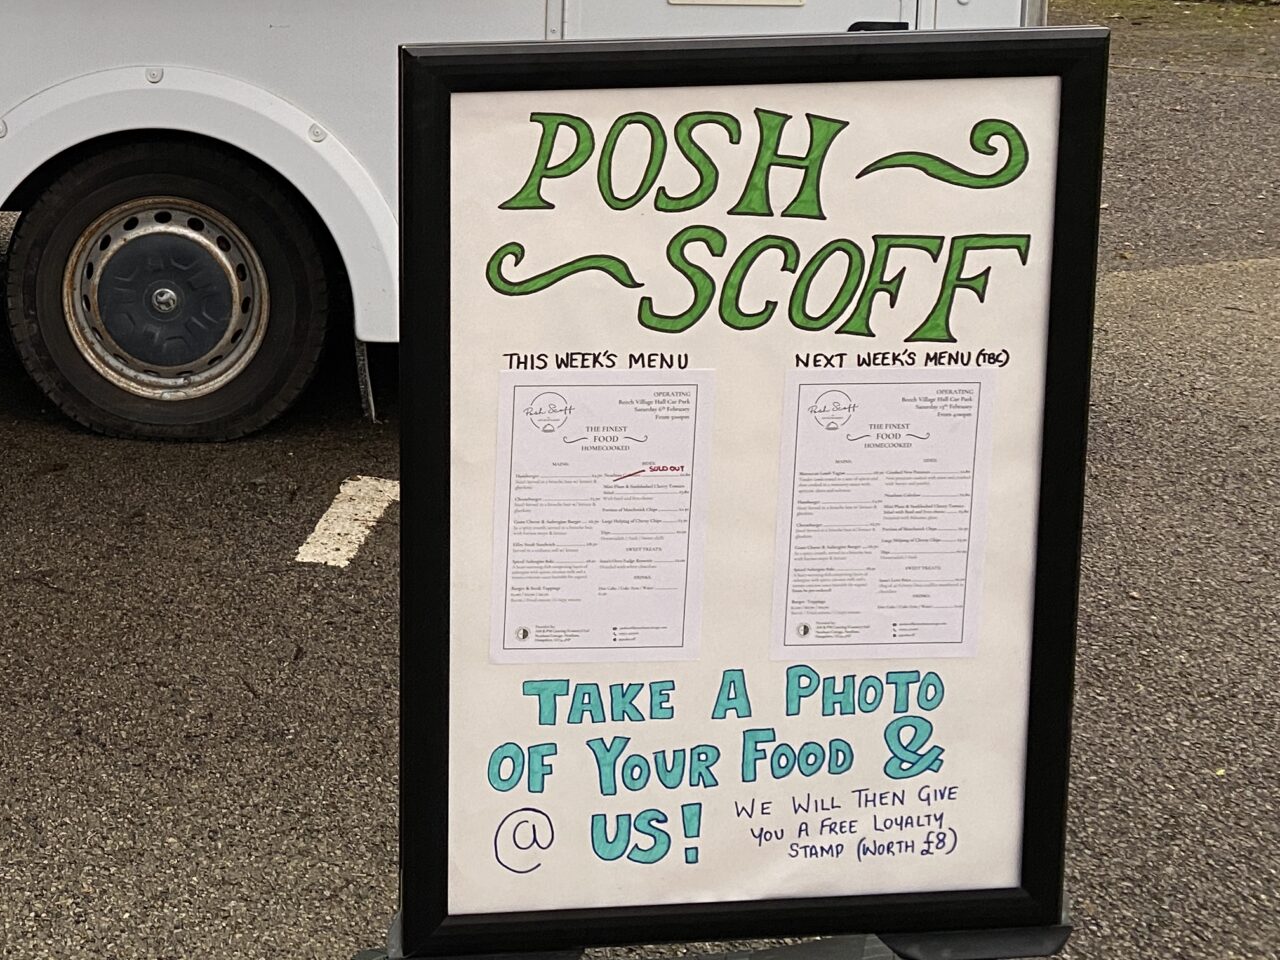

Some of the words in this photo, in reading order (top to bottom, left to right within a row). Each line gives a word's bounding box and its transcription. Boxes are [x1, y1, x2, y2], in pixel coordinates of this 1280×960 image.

[498, 108, 850, 220] POSH
[638, 224, 1032, 343] SCOFF
[503, 352, 549, 371] THIS
[555, 351, 619, 371] WEEK'S
[628, 353, 690, 370] MENU
[795, 353, 846, 369] NEXT
[857, 351, 917, 369] WEEK'S
[924, 352, 972, 368] MENU
[976, 348, 1011, 368] (TBC)
[635, 398, 654, 406] Village
[593, 435, 619, 443] FOOD
[523, 679, 675, 725] TAKE
[712, 669, 752, 720] A
[786, 665, 945, 716] PHOTO
[487, 742, 558, 793] OF
[587, 736, 720, 796] YOUR
[741, 728, 854, 782] FOOD
[883, 715, 944, 779] &
[735, 800, 773, 819] WE
[792, 792, 842, 814] WILL
[851, 787, 906, 810] THEN
[917, 784, 959, 804] GIVE
[494, 807, 555, 873] @
[591, 803, 703, 864] US!
[751, 826, 785, 846] YOU
[797, 821, 810, 838] A
[818, 817, 858, 836] FREE
[872, 811, 944, 833] LOYALTY
[788, 841, 845, 859] STAMP
[856, 838, 916, 862] (WORTH
[920, 827, 959, 858] £8)
